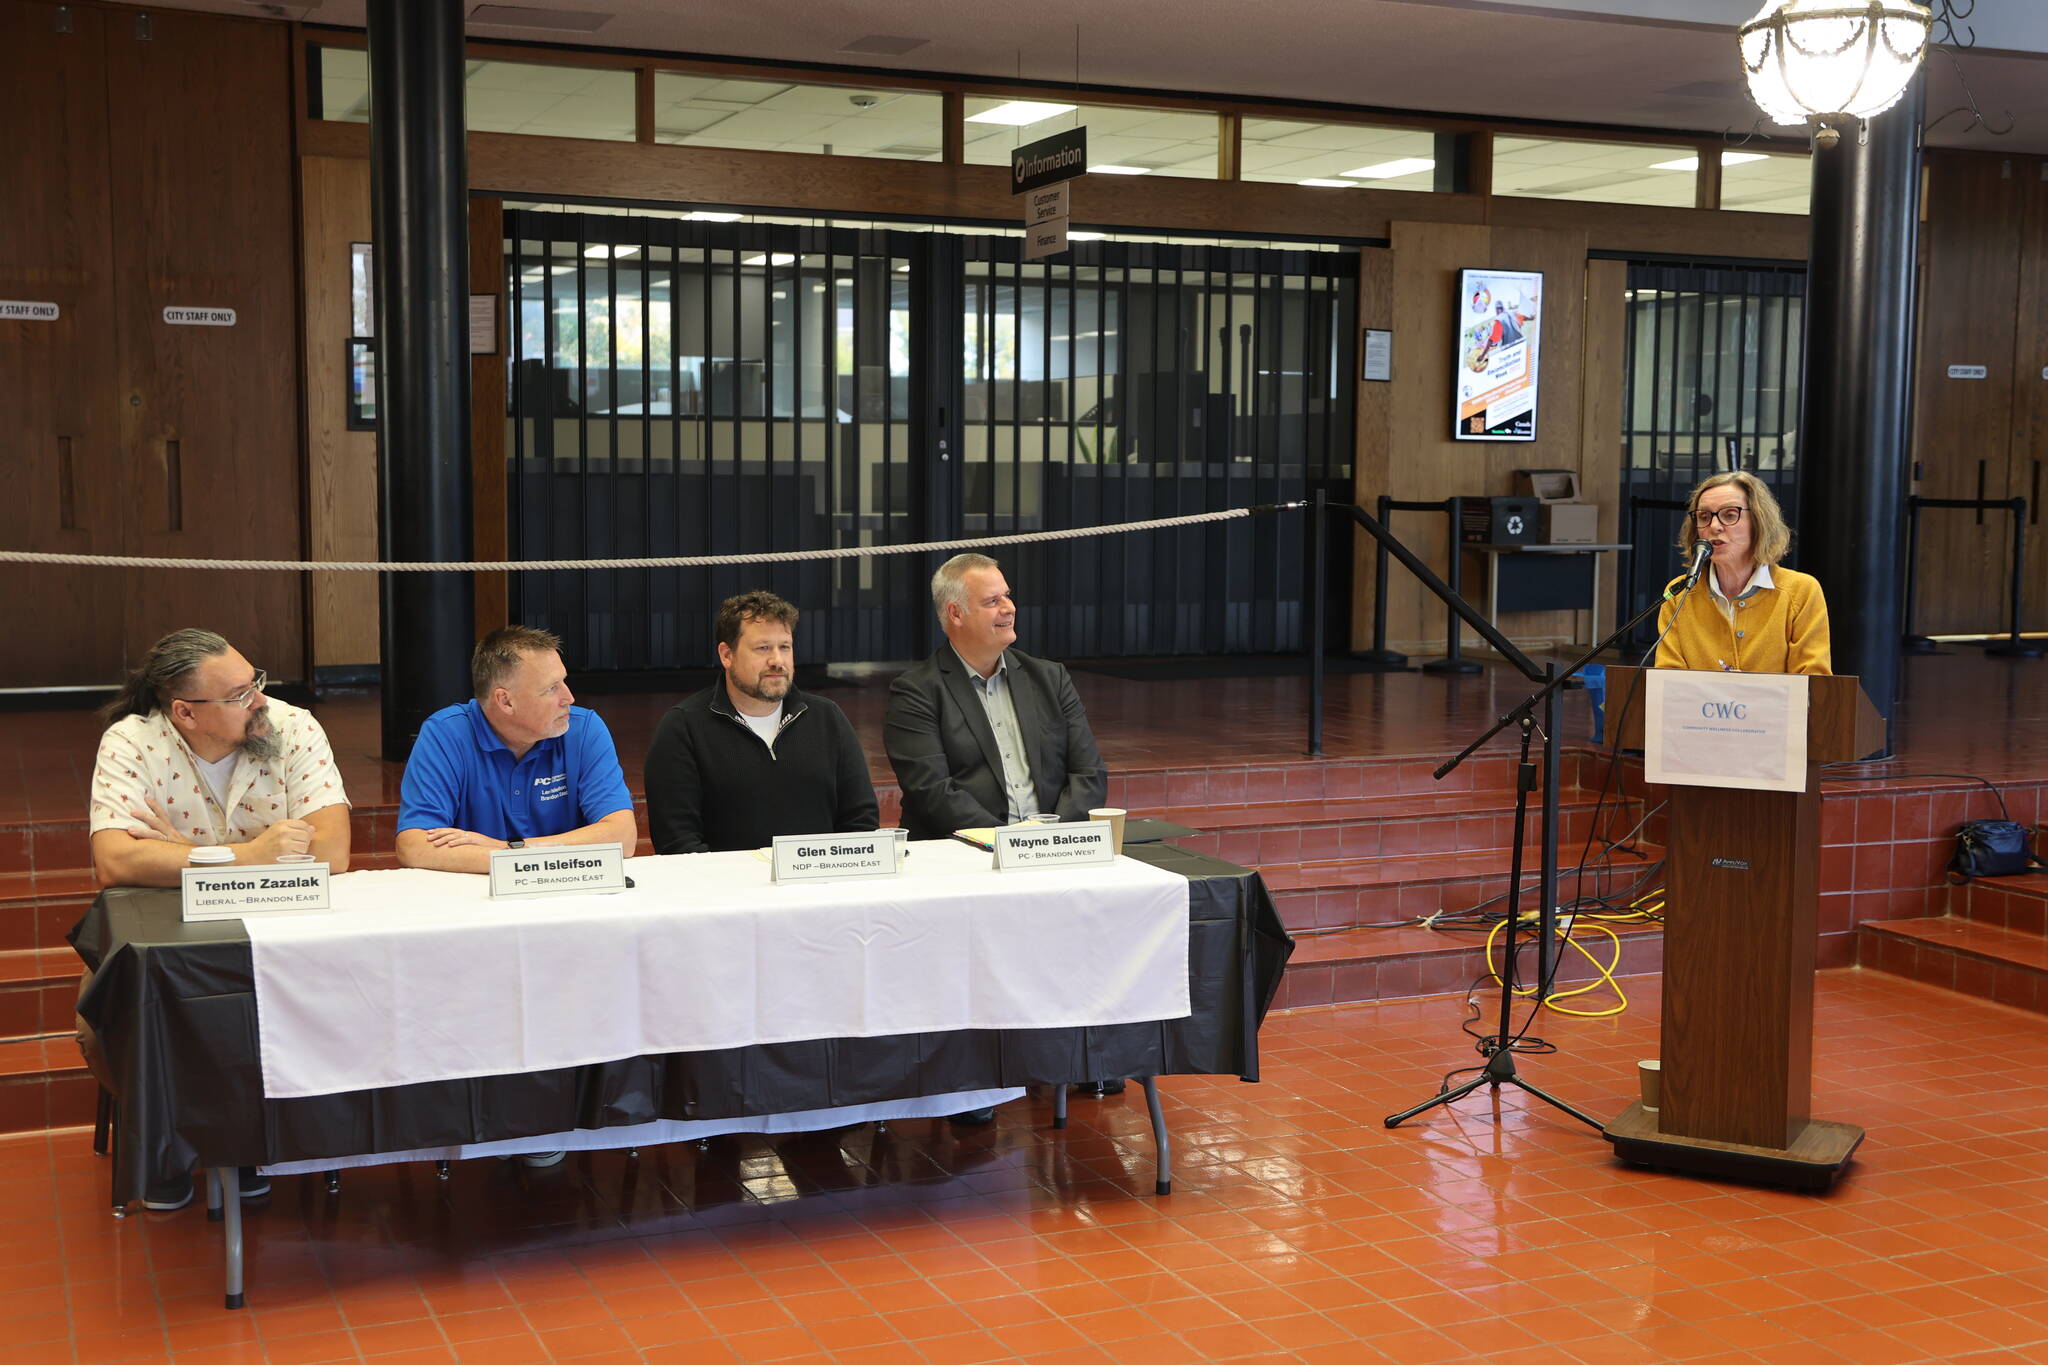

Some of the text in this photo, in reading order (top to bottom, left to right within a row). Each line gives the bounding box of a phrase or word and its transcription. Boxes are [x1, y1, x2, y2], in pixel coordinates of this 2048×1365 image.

[1033, 191, 1060, 207] Customer
[1037, 205, 1057, 219] Service
[1037, 234, 1057, 247] Finance
[6, 305, 30, 315] STAFF
[32, 306, 56, 316] ONLY
[166, 311, 233, 322] CITY STAFF ONLY
[1701, 700, 1747, 720] CWC
[534, 777, 551, 786] PC
[1009, 834, 1101, 849] Wayne Balcaen
[797, 844, 874, 857] Glen Simard
[1035, 851, 1073, 859] BRANDON
[514, 859, 602, 873] Len Isleifson
[792, 863, 812, 871] NDP
[860, 860, 881, 868] EAST
[195, 877, 319, 892] Trenton Zazalak
[196, 897, 237, 906] LIBERAL
[295, 894, 320, 902] EAST
